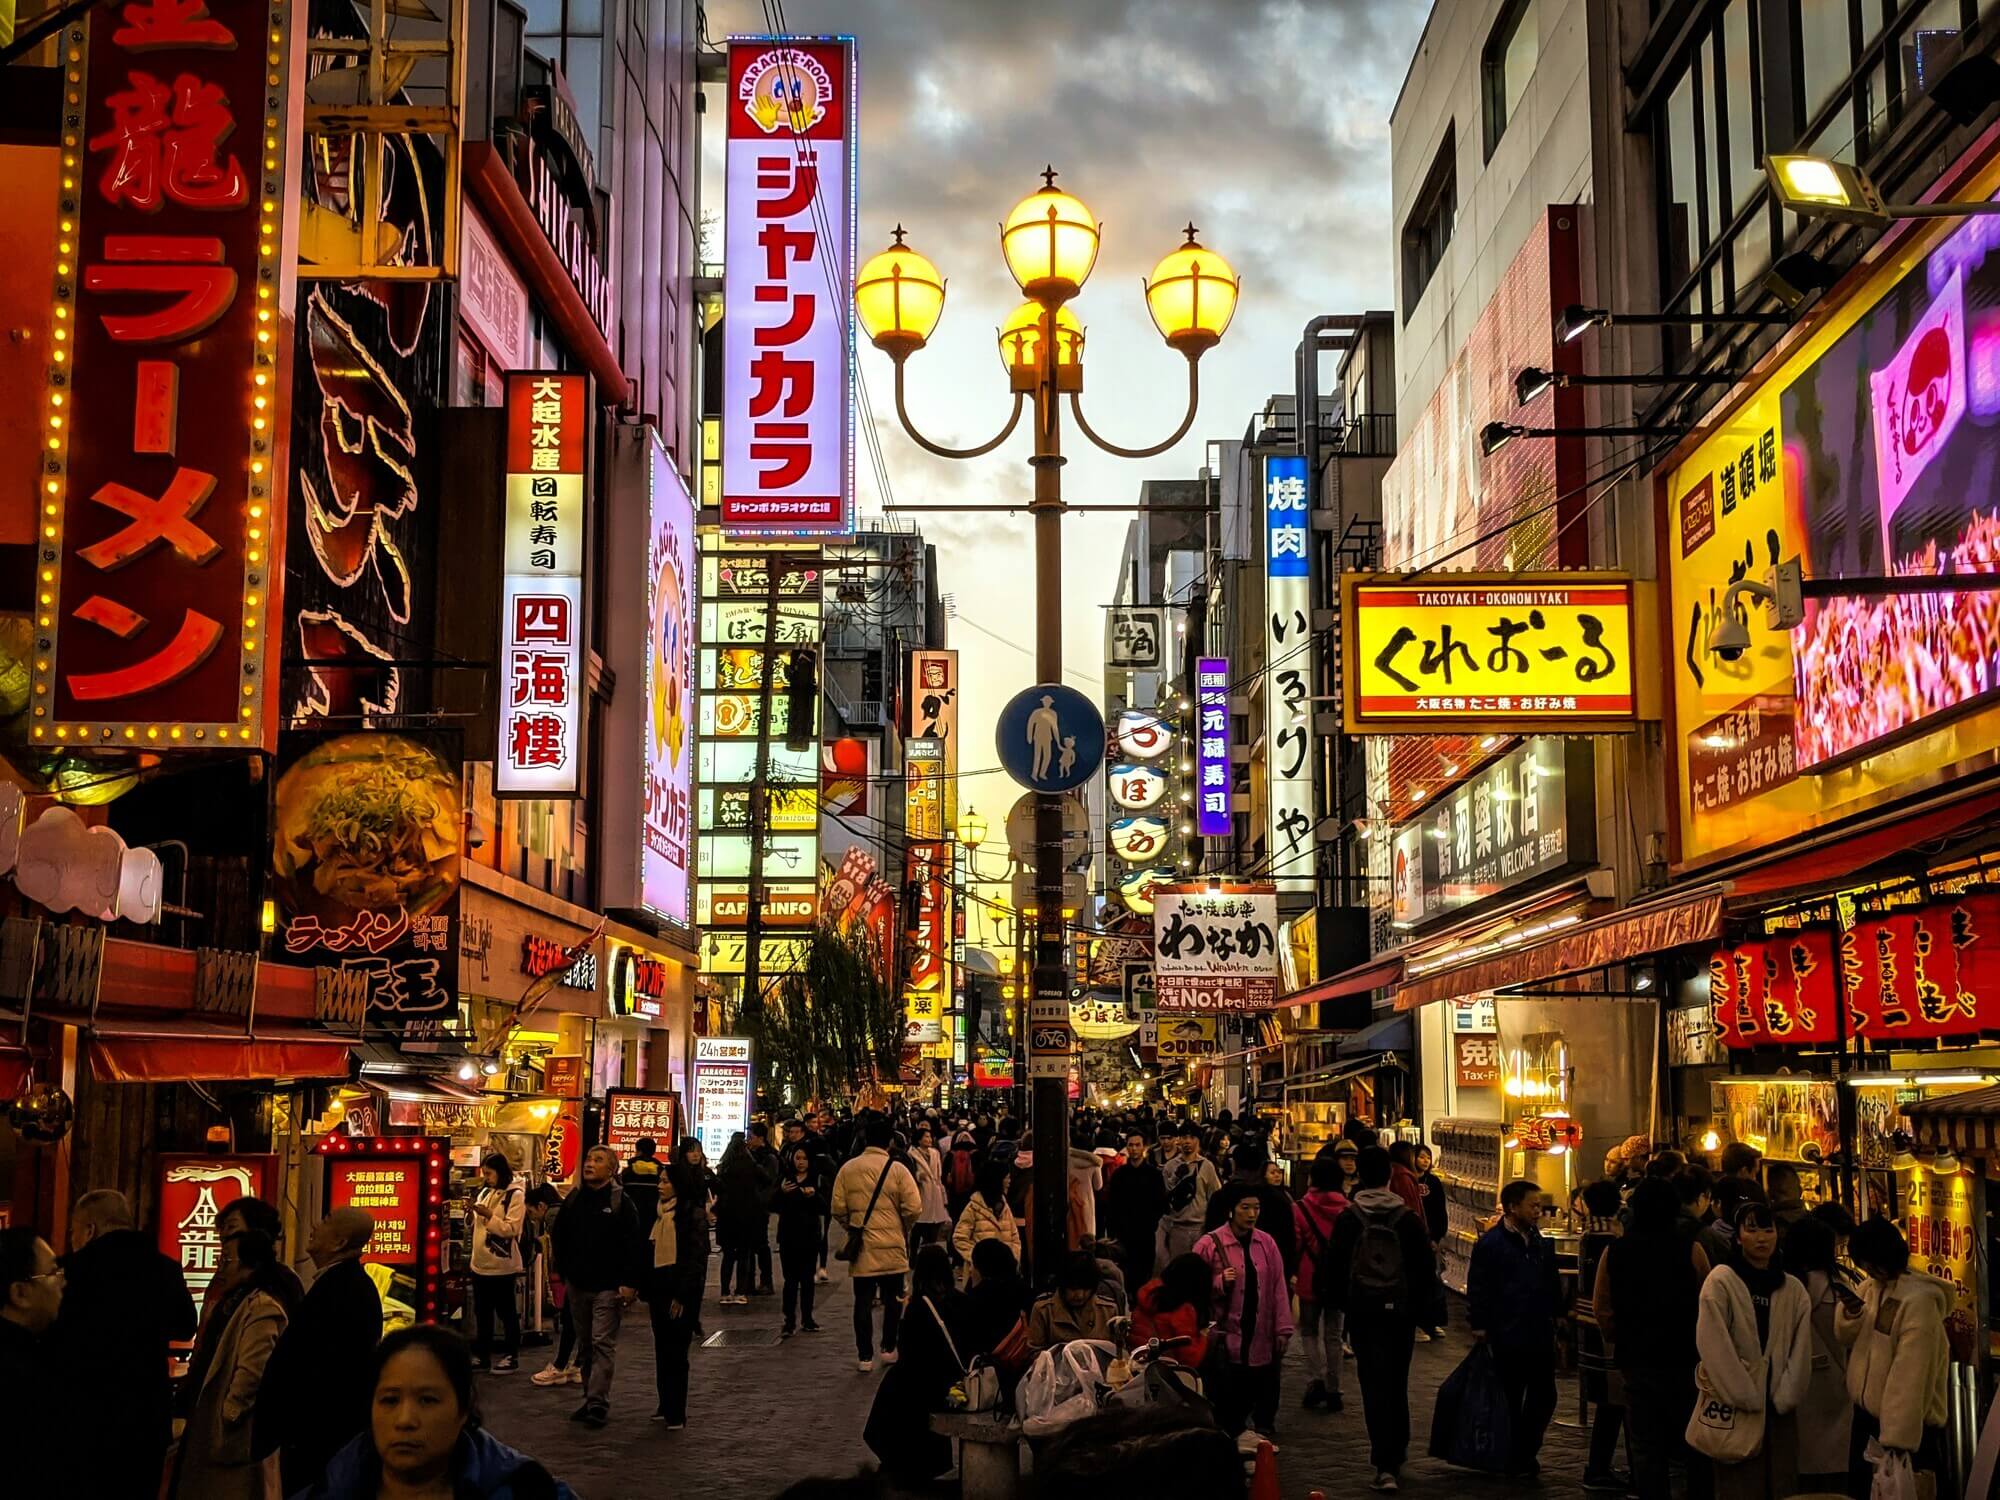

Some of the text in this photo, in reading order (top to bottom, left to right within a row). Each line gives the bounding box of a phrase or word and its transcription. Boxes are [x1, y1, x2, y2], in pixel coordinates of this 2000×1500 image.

[748, 150, 818, 490] ジャンカラ
[530, 377, 562, 472] 大起水産
[1719, 428, 1776, 519] 道頓堀
[529, 477, 558, 570] 回転寿司
[730, 502, 832, 514] ジャンボカラオケ広場
[1268, 476, 1308, 559] 焼肉
[1375, 610, 1616, 692] くれおーる
[512, 597, 570, 766] 四海樓
[1416, 697, 1466, 711] 大阪名物
[1272, 609, 1310, 854] いろりや
[1203, 712, 1226, 814] 元禄寿司
[1500, 840, 1535, 879] WELCOME
[285, 904, 408, 953] ラーメン
[714, 902, 748, 915] CAF
[771, 902, 813, 915] INFO
[413, 933, 447, 950] 라면
[1158, 913, 1275, 961] わなか
[914, 997, 932, 1014] 薬
[612, 1113, 670, 1129] 回転寿司
[616, 1100, 669, 1113] 大起水産
[1908, 1180, 1926, 1206] 2F
[374, 1232, 401, 1241] 라면집
[387, 1220, 406, 1230] 제일
